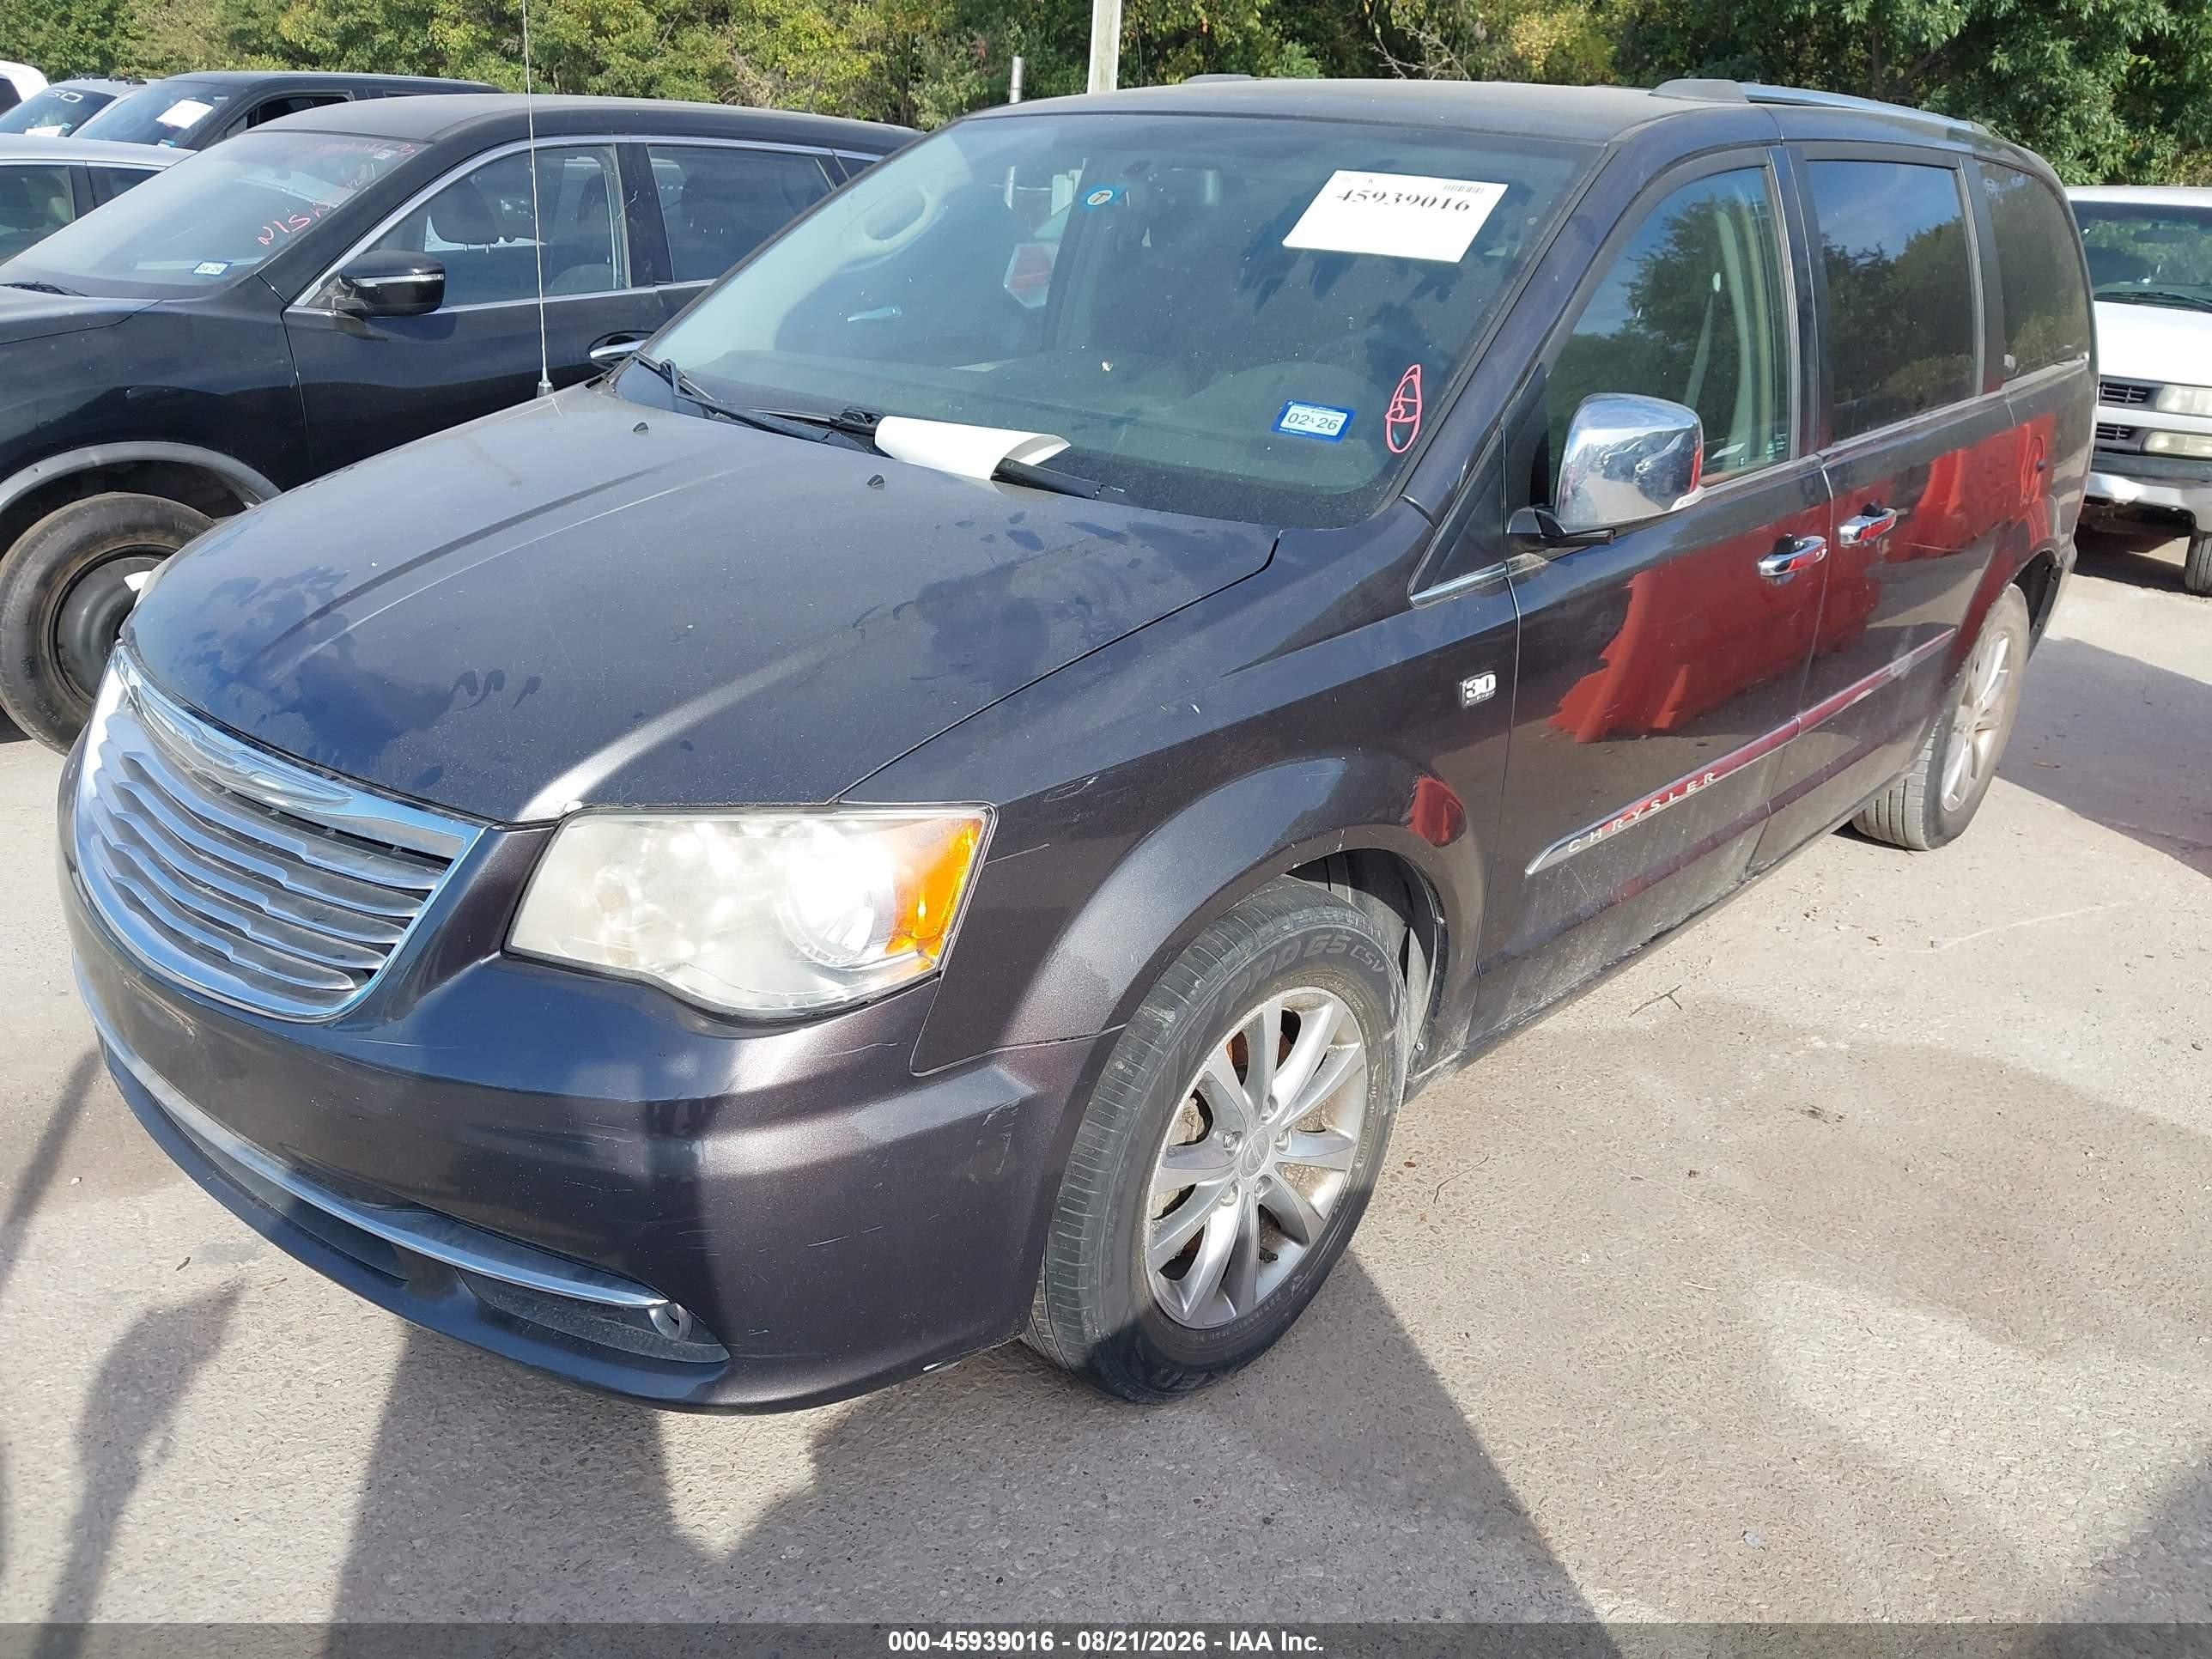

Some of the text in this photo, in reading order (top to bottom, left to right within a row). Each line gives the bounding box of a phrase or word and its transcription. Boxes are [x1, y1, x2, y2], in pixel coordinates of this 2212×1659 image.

[1336, 189, 1471, 212] 45939016
[1288, 413, 1340, 430] 02 26
[1465, 674, 1496, 699] 30
[1567, 772, 1716, 853] CHRYSLER
[1349, 944, 1385, 973] CSV
